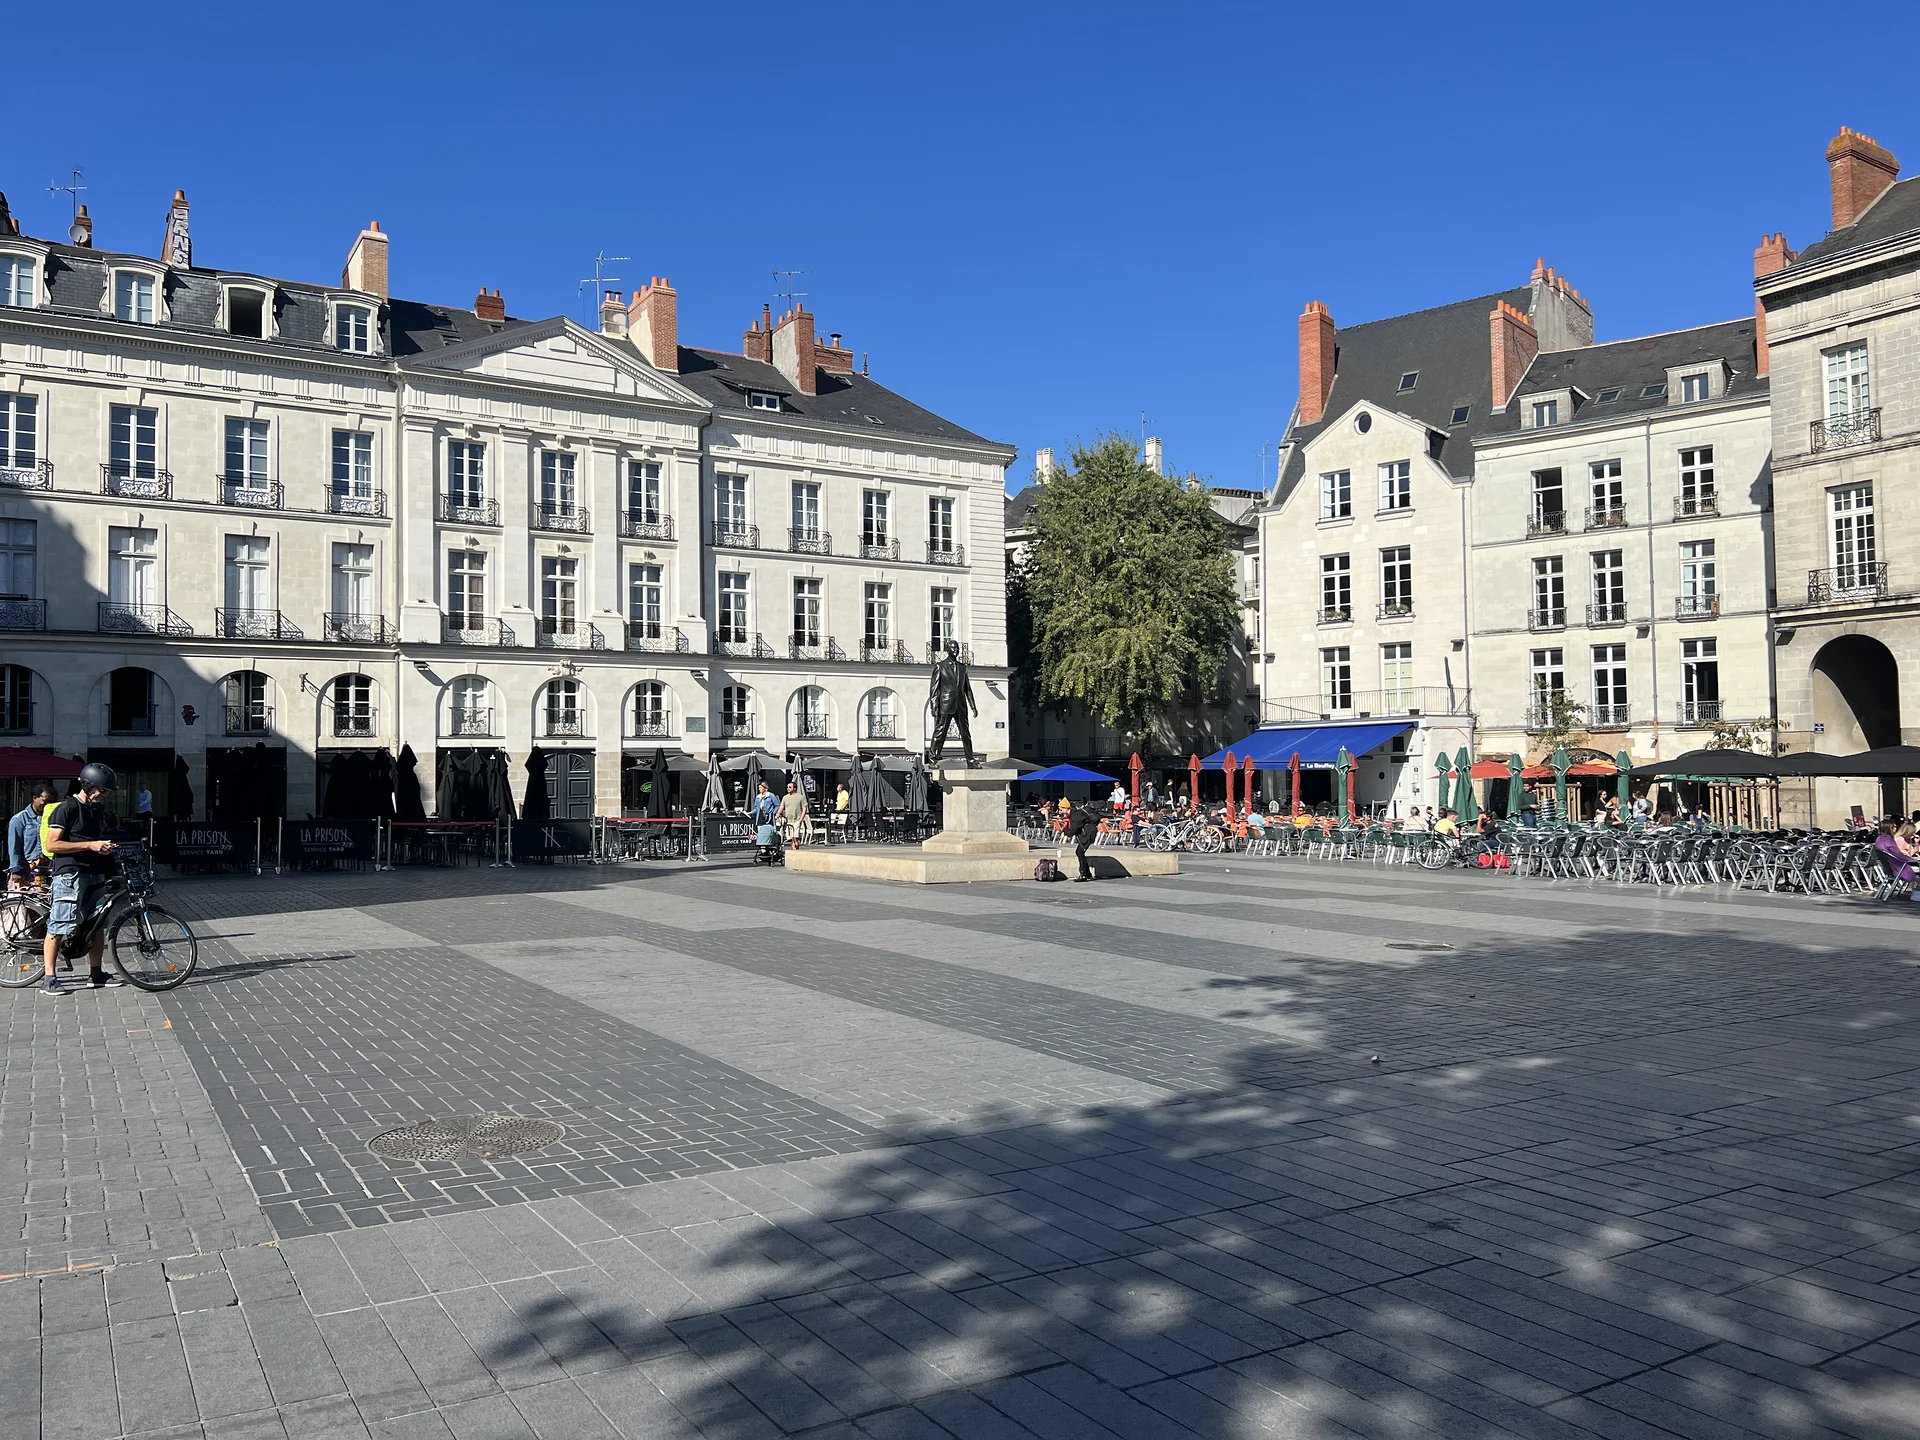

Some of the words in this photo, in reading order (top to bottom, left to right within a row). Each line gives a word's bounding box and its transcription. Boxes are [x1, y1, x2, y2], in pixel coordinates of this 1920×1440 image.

[300, 828, 311, 842] LA
[315, 828, 352, 842] PRISON
[719, 823, 728, 836] LA
[729, 823, 757, 836] PRISON
[176, 830, 187, 845] LA
[191, 830, 231, 845] PRISON
